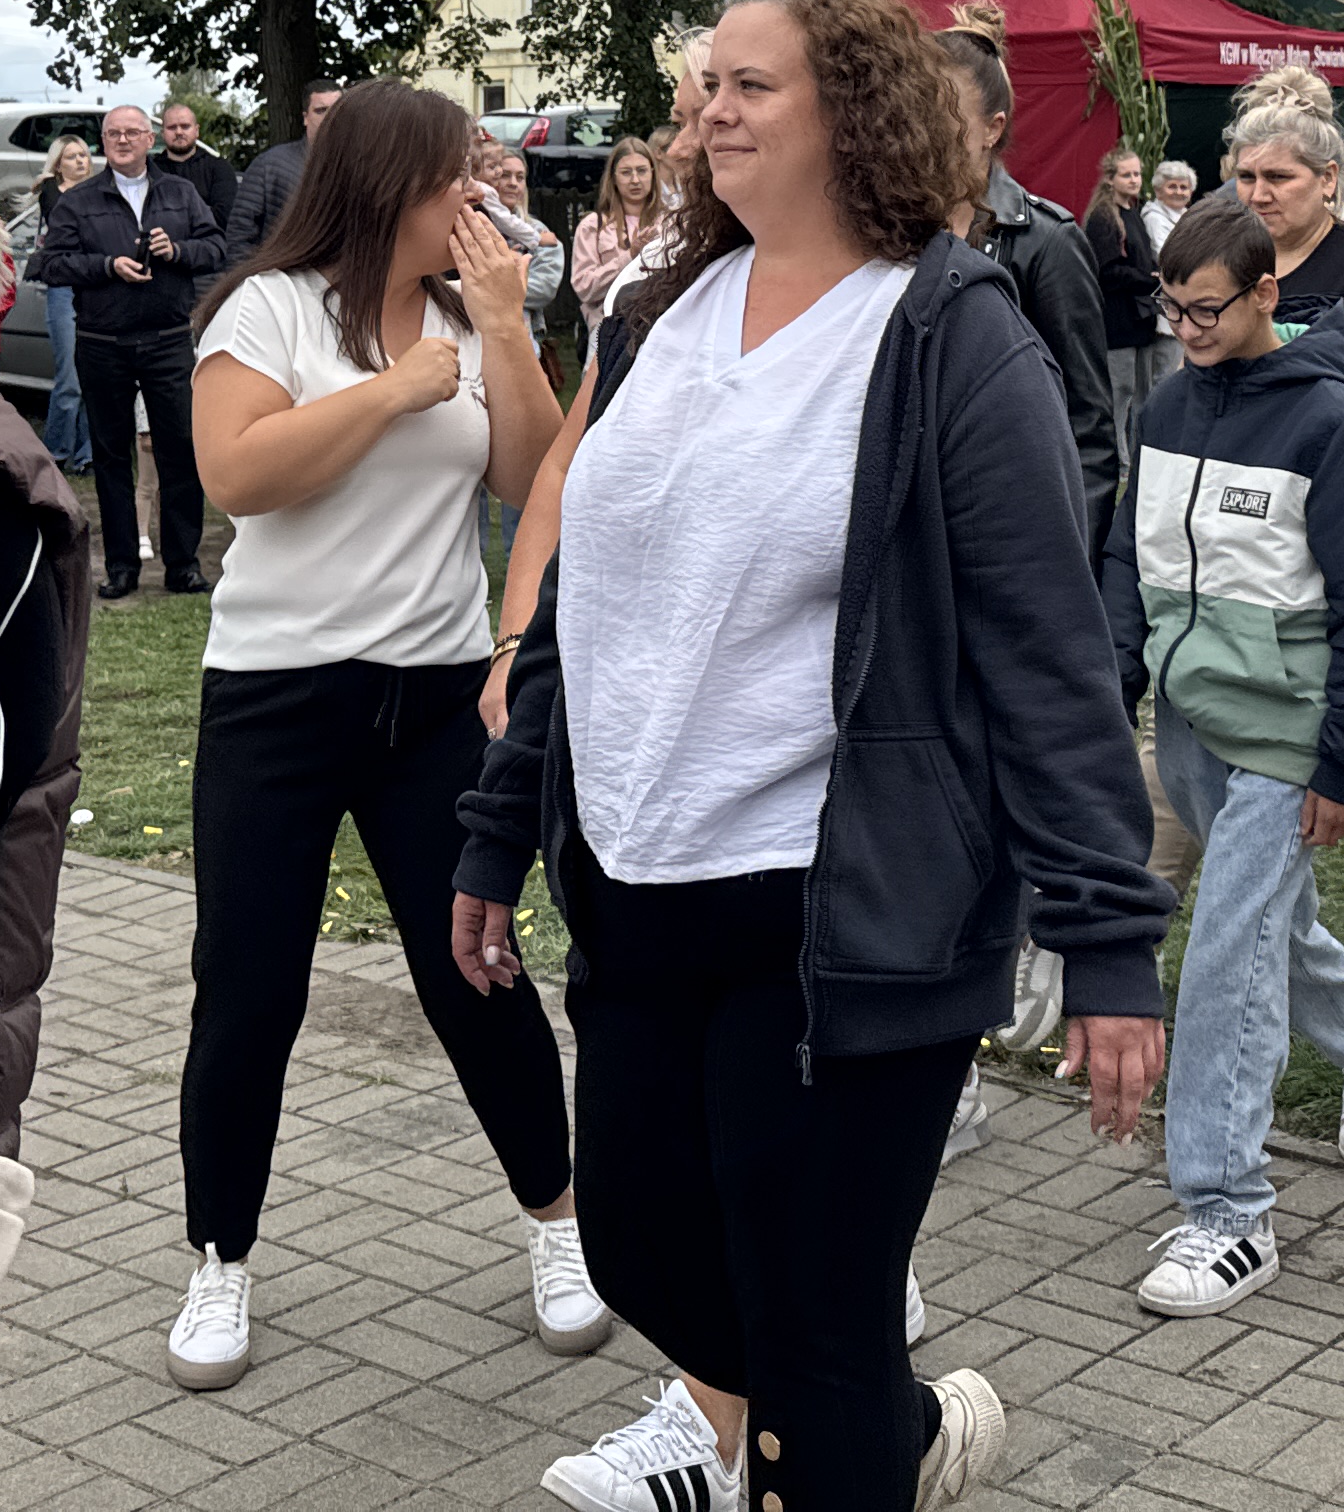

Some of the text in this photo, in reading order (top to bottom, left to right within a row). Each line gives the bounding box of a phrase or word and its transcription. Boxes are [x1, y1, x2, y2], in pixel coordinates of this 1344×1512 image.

[1219, 41, 1240, 65] KGW
[1240, 48, 1248, 65] w
[1222, 489, 1267, 512] EXPLORE
